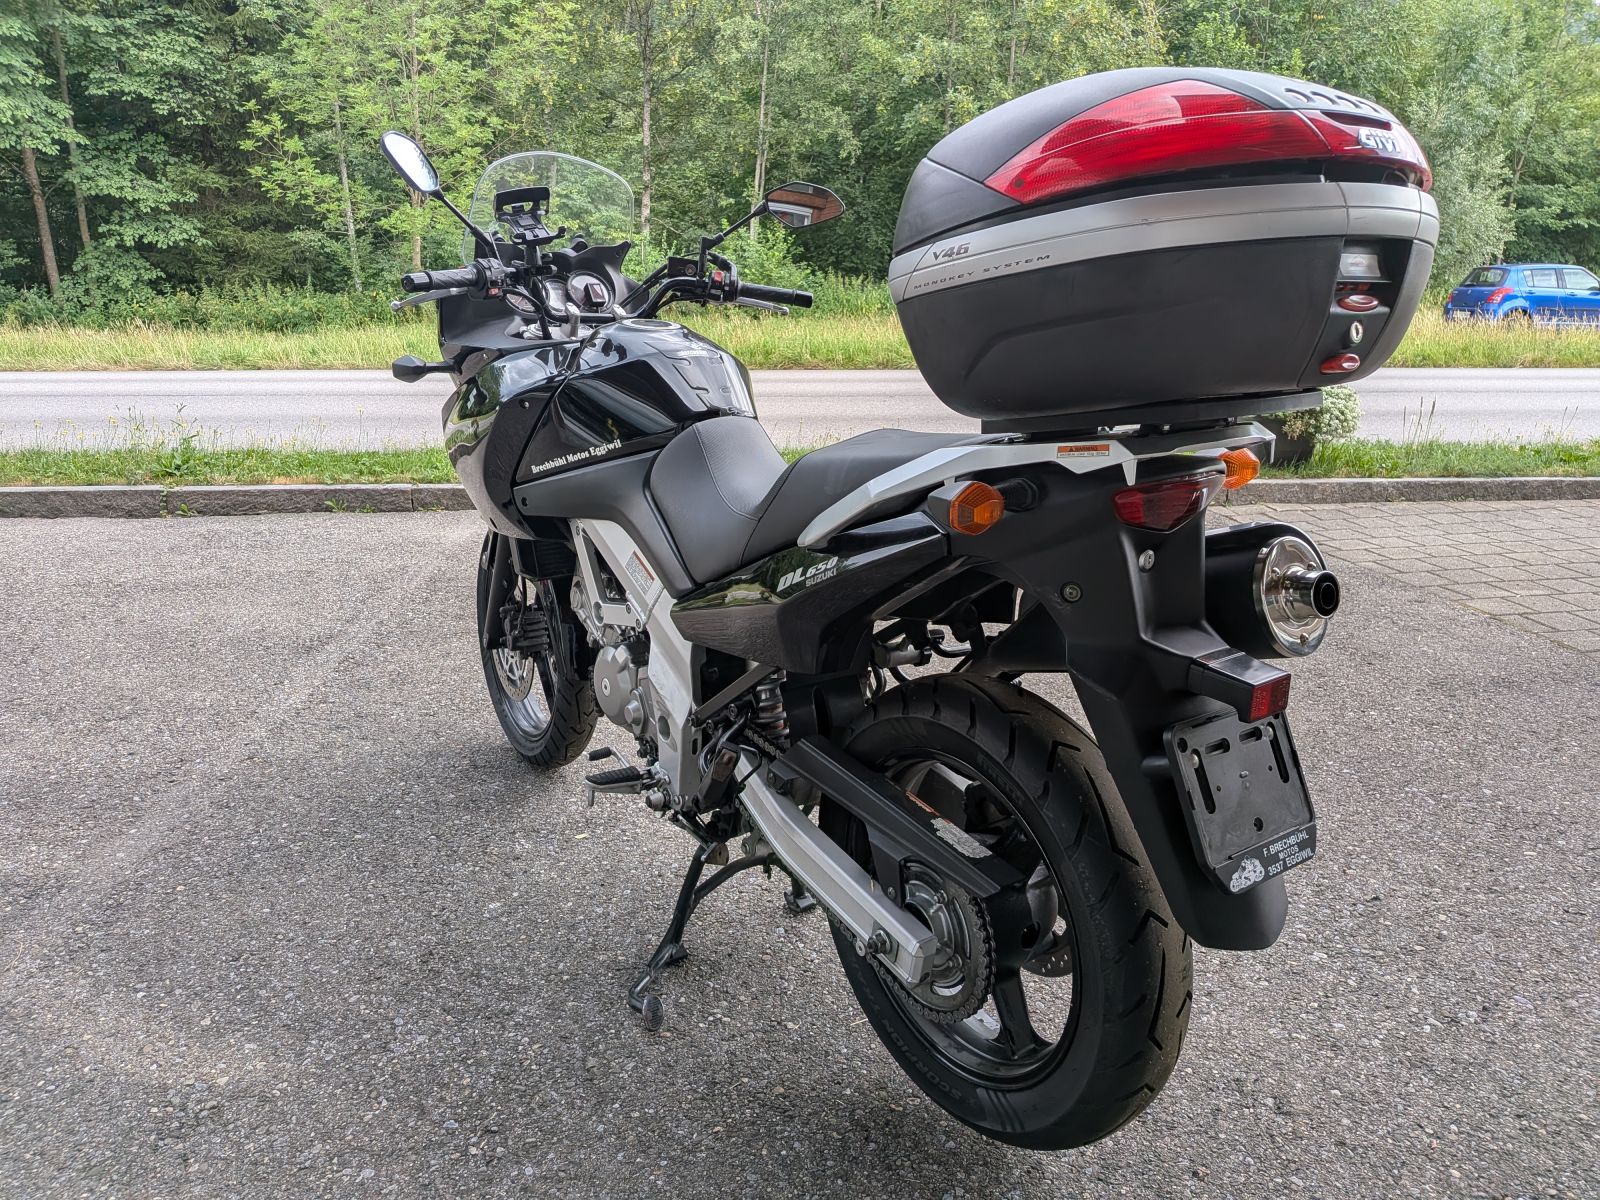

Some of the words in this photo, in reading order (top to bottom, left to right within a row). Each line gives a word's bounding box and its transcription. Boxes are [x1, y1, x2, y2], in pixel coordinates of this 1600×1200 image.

[1358, 129, 1401, 153] GIVI
[932, 242, 971, 261] V46
[913, 271, 975, 290] MONOKEY
[982, 254, 1051, 273] SYSTEM
[531, 456, 567, 474] Brechbühl
[566, 450, 590, 464] Motos
[589, 438, 622, 457] Eggiwil
[805, 567, 837, 588] SUZUKI
[1269, 830, 1310, 855] BRECHBÜHL
[1278, 844, 1299, 860] MOTOS
[1267, 860, 1284, 877] 3537
[1285, 847, 1315, 868] EGGIWIL
